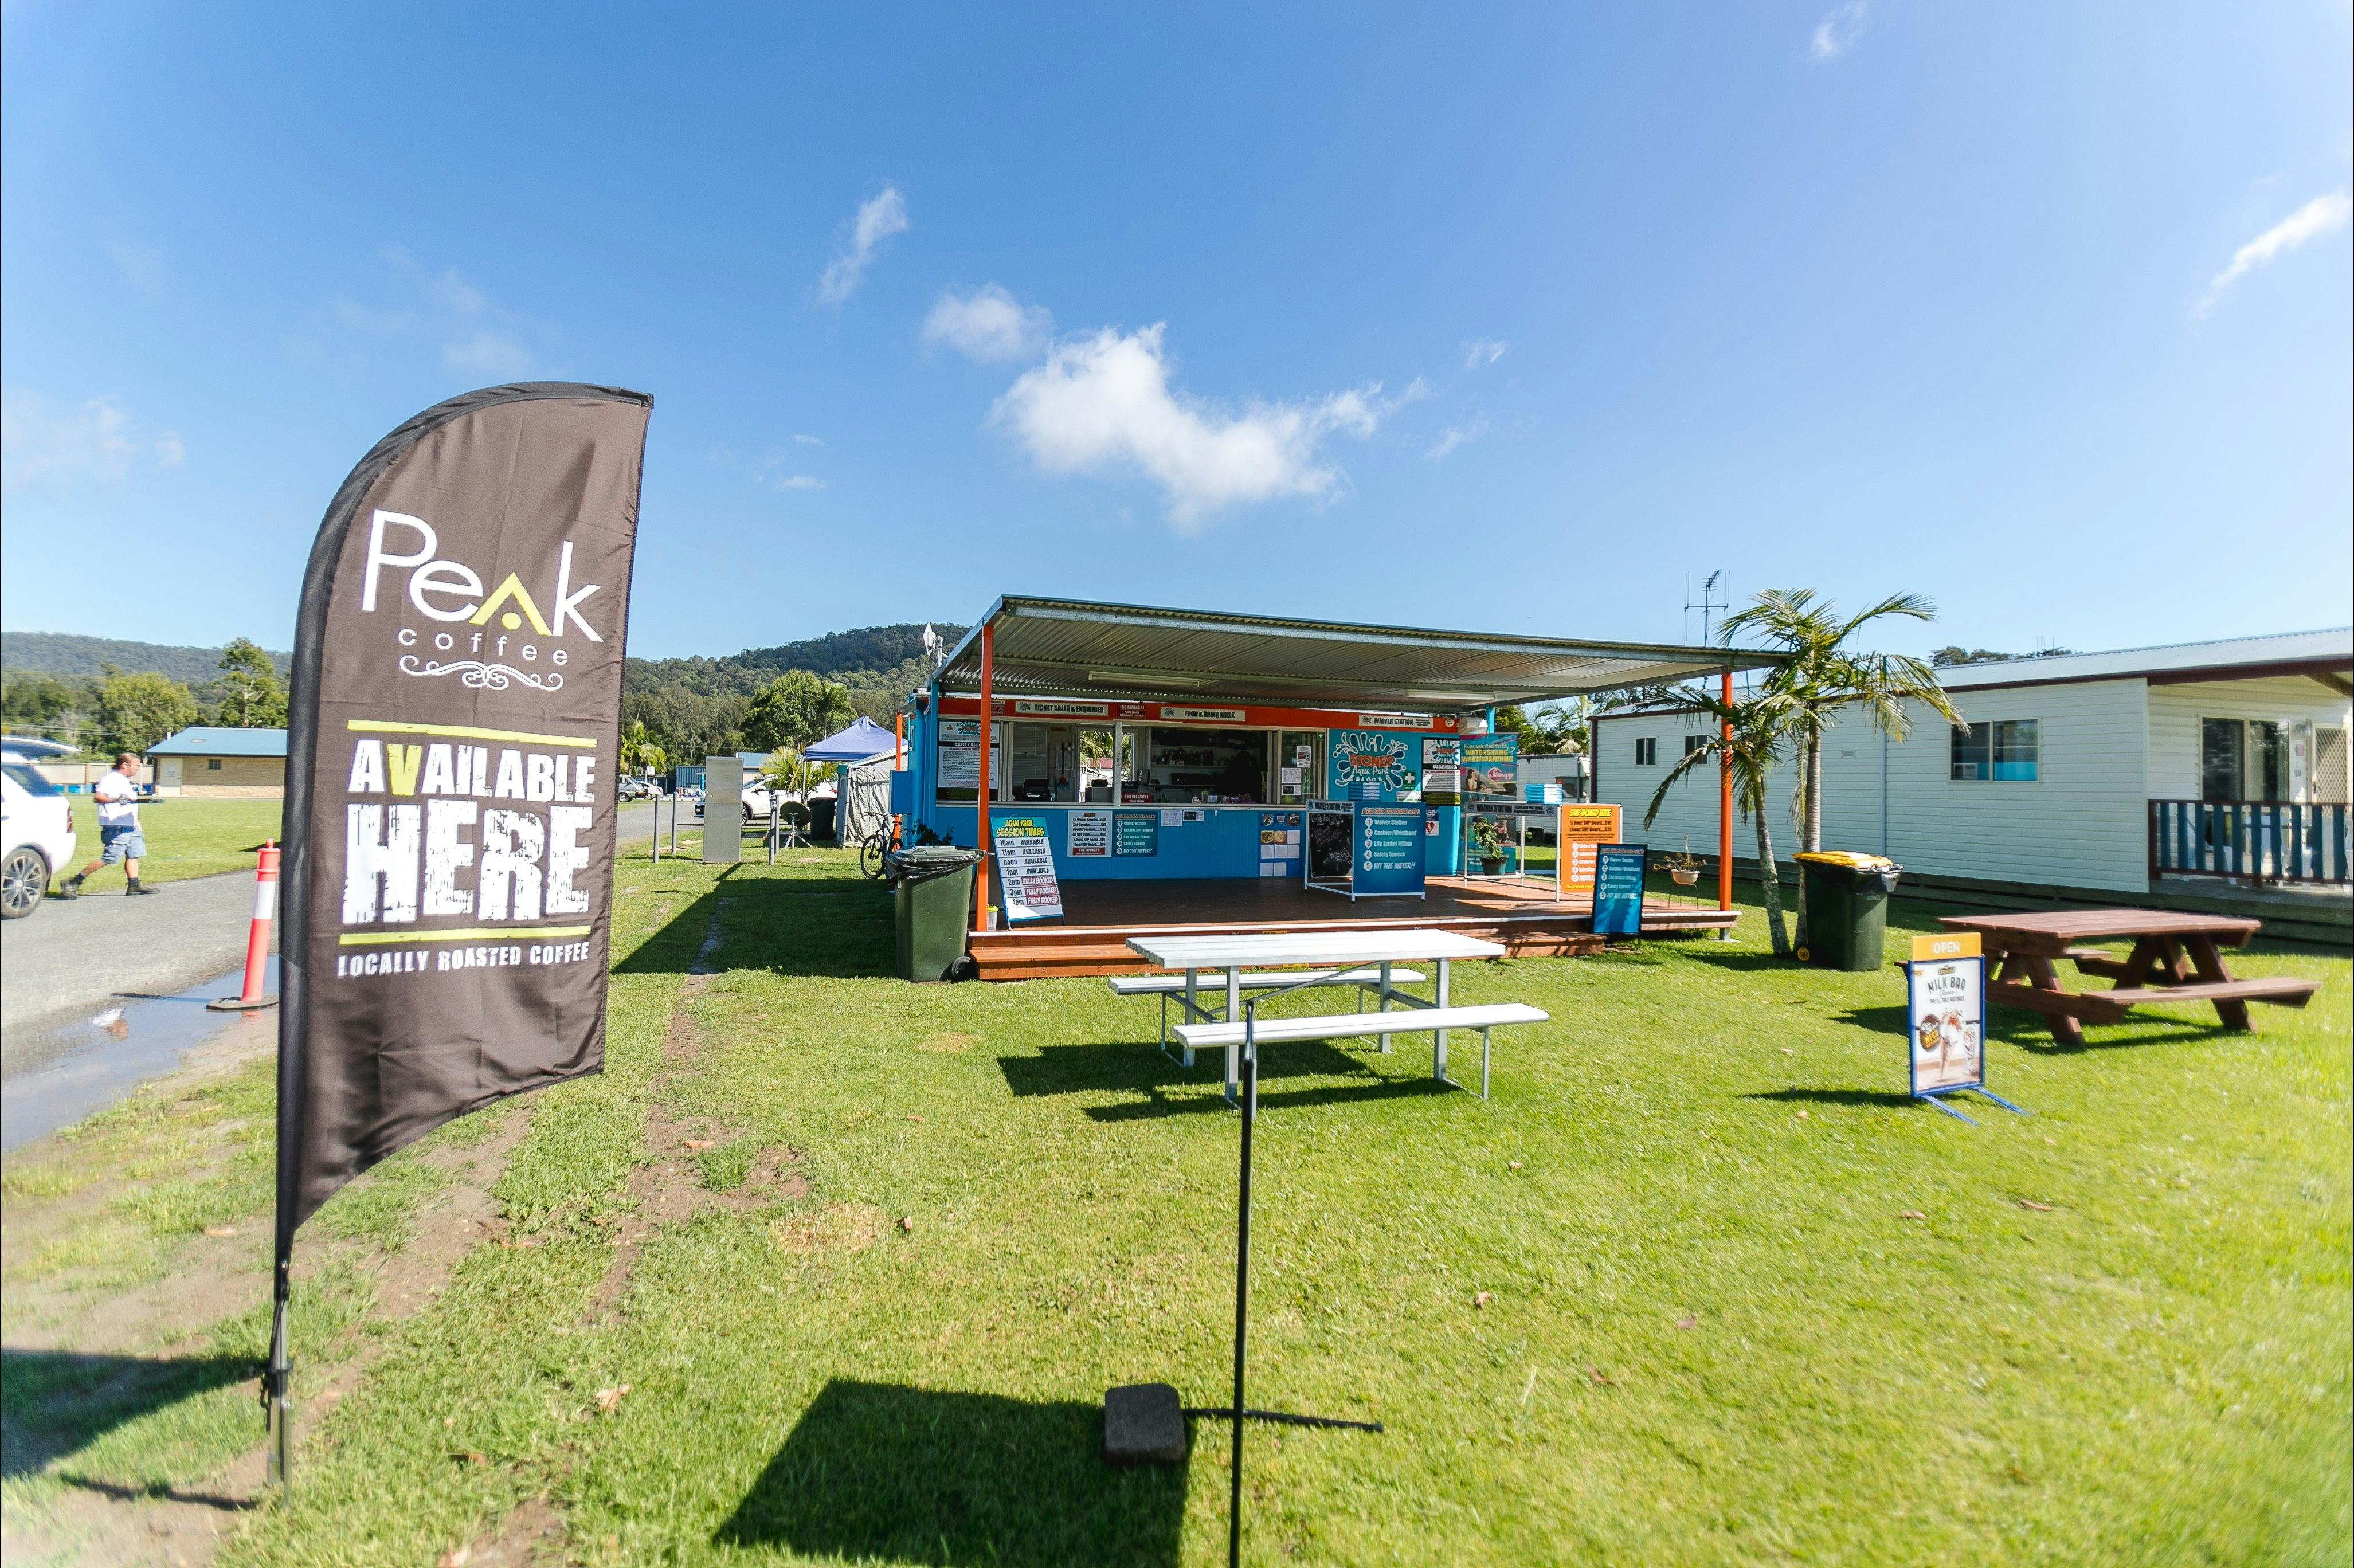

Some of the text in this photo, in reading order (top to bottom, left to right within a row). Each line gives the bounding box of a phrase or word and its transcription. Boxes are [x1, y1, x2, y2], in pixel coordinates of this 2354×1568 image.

[398, 628, 569, 666] coffee
[1076, 705, 1104, 714] ENQUIRIES
[1350, 754, 1396, 767] STONEY
[348, 739, 597, 803] AVAILABLE
[1352, 765, 1389, 776] Aqua Park
[1489, 769, 1514, 780] Stoney
[1494, 804, 1512, 813] STATION
[997, 827, 1044, 837] SESSION TIMES
[343, 799, 593, 924] HERE
[1040, 886, 1056, 894] BOOKED
[1933, 941, 1960, 954] OPEN
[338, 942, 589, 977] LOCALLY ROASTED COFFEE
[1928, 977, 1966, 994] MILK BAR
